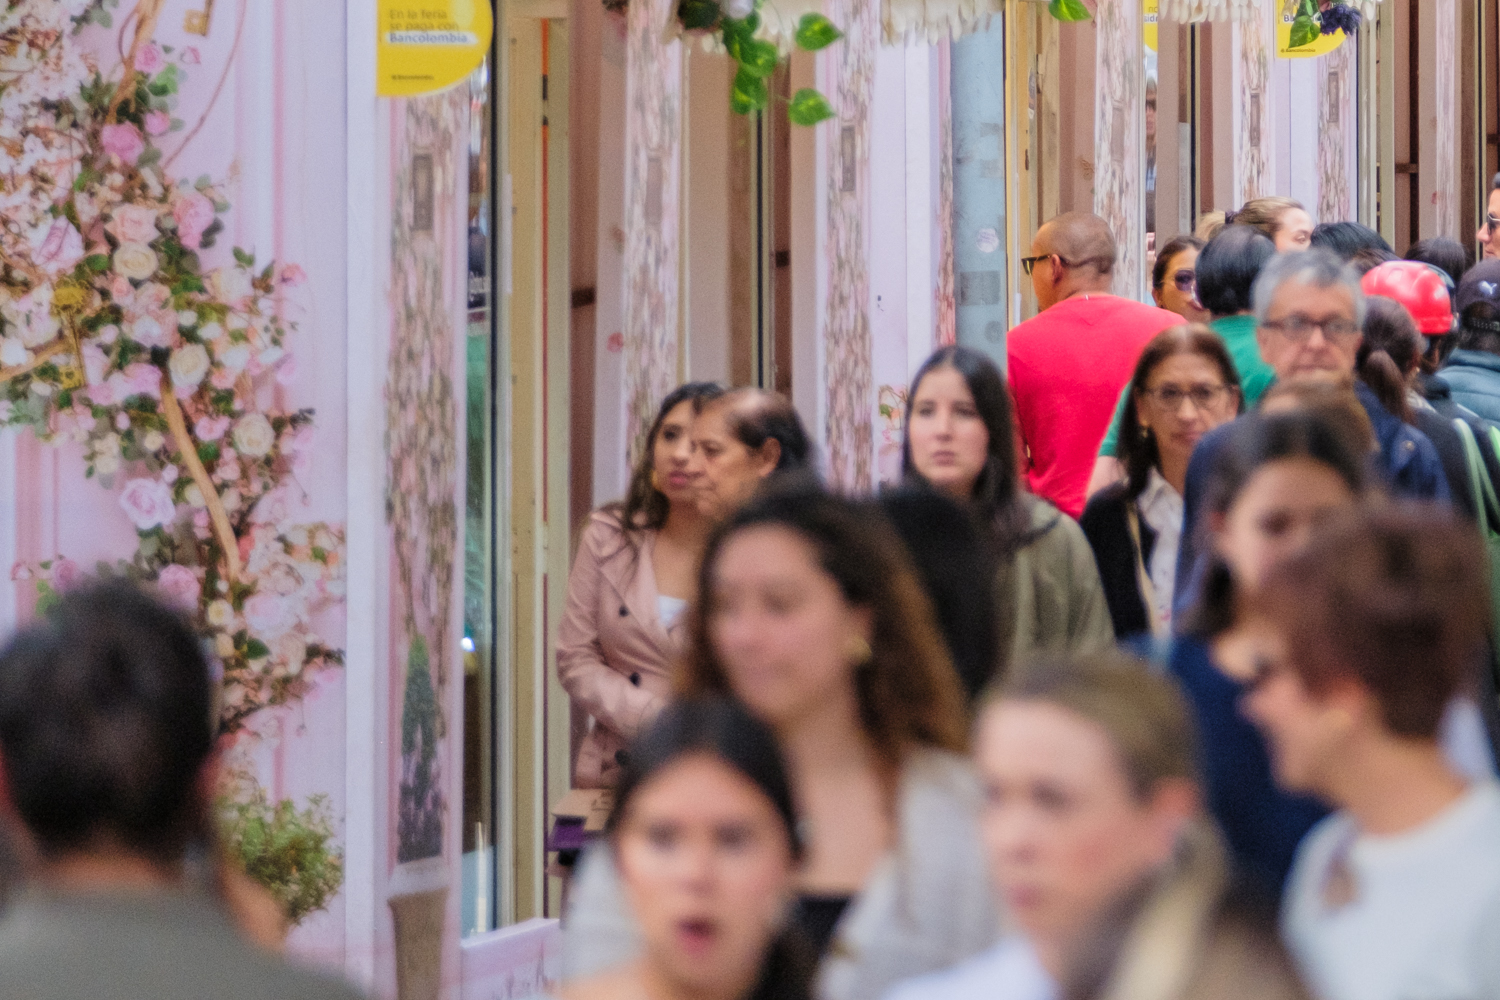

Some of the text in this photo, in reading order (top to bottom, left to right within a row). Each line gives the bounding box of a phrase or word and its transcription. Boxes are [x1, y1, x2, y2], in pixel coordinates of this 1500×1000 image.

[389, 9, 447, 19] En la feria
[389, 32, 468, 43] Bancolombia
